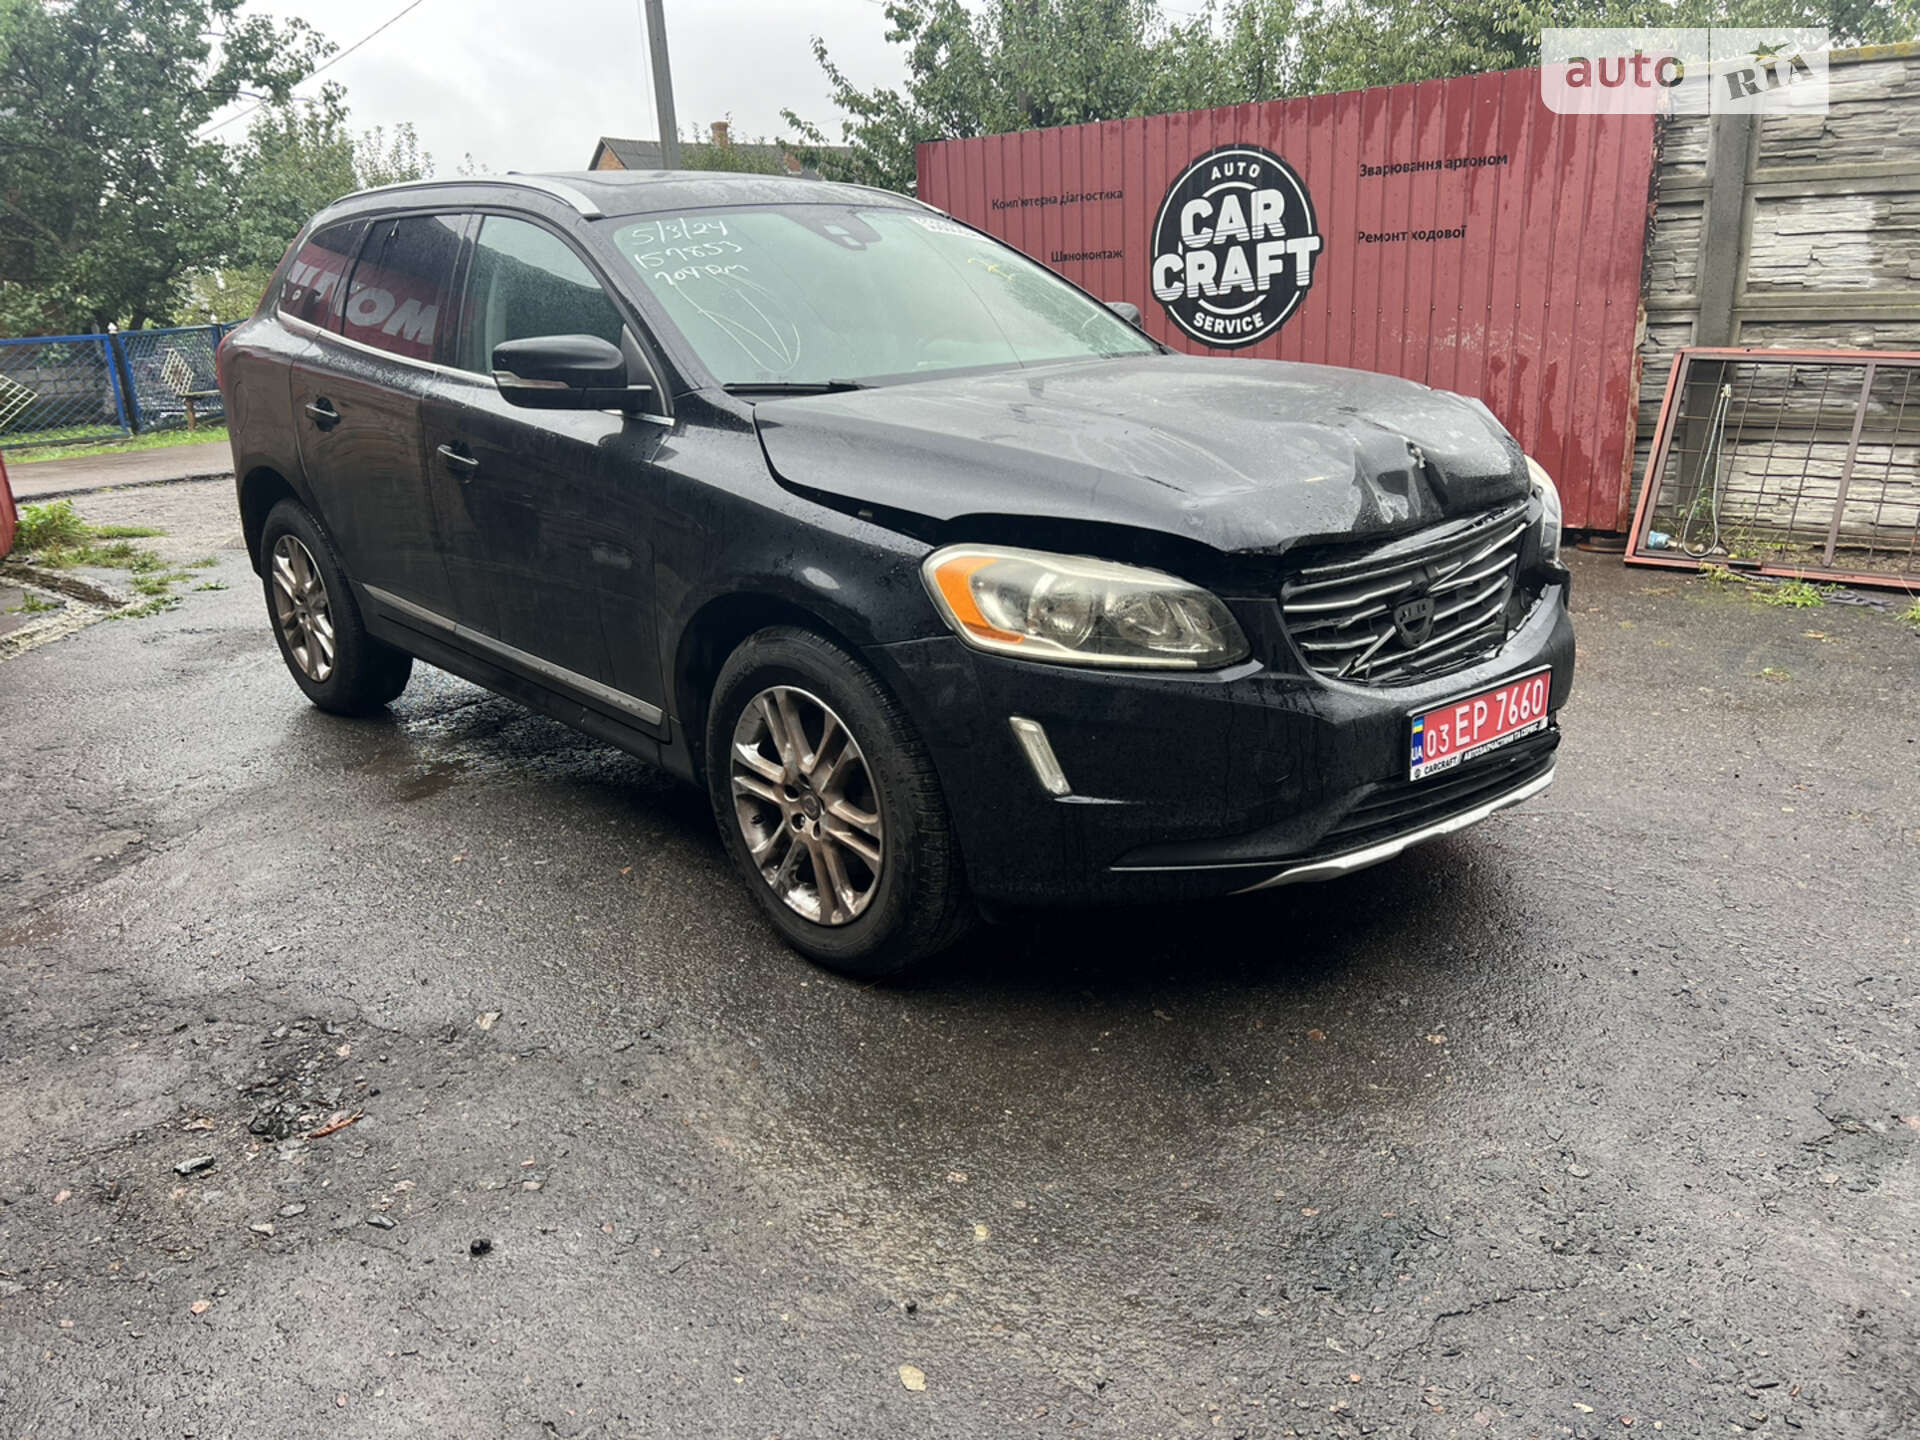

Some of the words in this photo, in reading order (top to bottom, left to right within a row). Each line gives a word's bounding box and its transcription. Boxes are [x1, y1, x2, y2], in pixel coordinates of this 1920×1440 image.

[1211, 161, 1260, 181] AUTO
[1359, 159, 1442, 178] Зварювання
[1444, 153, 1508, 172] аргоном
[1060, 190, 1123, 206] діагностика
[1181, 188, 1286, 248] CAR
[631, 217, 728, 246] 5/3/24
[1358, 230, 1408, 244] Ремонт
[1411, 225, 1467, 242] ходової
[1051, 249, 1123, 263] Шиномонтаж
[1152, 235, 1320, 302] CRAFT
[1193, 311, 1265, 335] SERVICE
[1426, 722, 1449, 758] 03
[1496, 679, 1543, 732] 7660
[1411, 744, 1424, 761] UA
